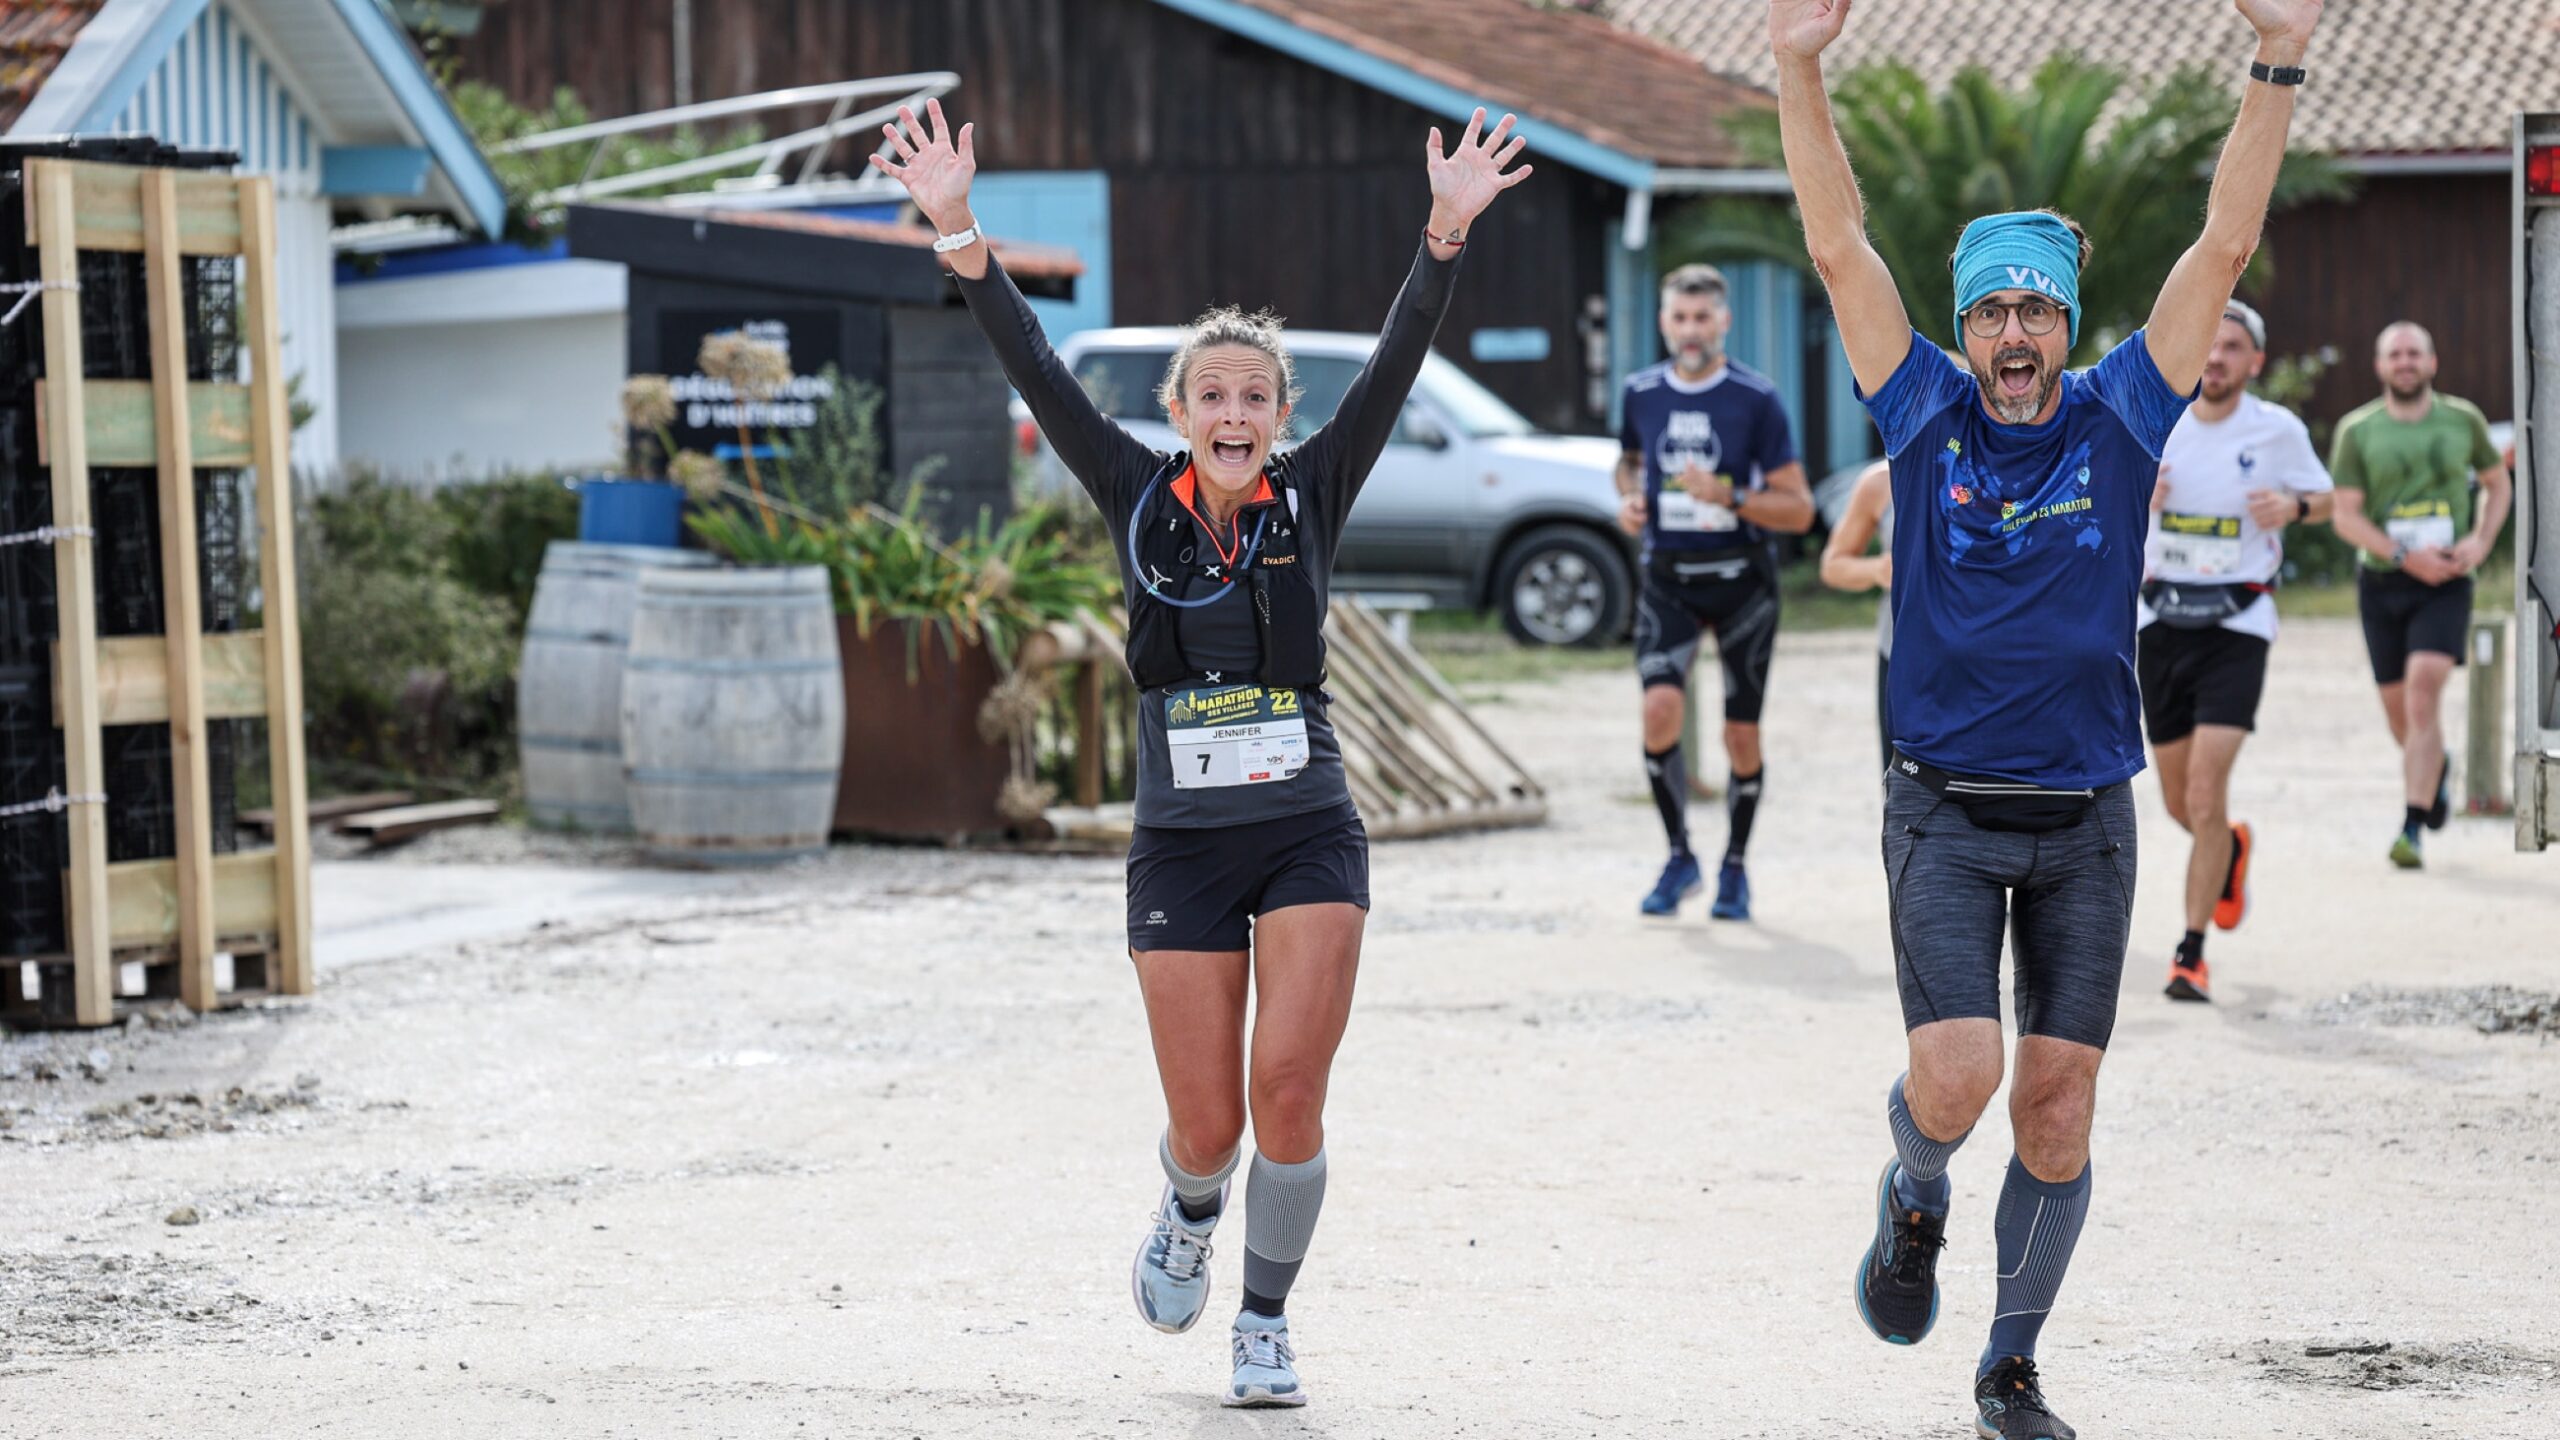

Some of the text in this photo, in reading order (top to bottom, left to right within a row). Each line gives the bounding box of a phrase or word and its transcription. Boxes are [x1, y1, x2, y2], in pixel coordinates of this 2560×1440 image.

[669, 374, 832, 402] DÉGUTION
[2039, 506, 2049, 518] ES
[2051, 497, 2092, 515] MARATÓN
[1263, 555, 1295, 565] EVADICT
[1197, 687, 1263, 712] MARATHON
[1222, 701, 1256, 715] VILLAGES
[1269, 691, 1298, 711] 22
[1212, 726, 1262, 739] JENNIFER
[1197, 753, 1211, 775] 7
